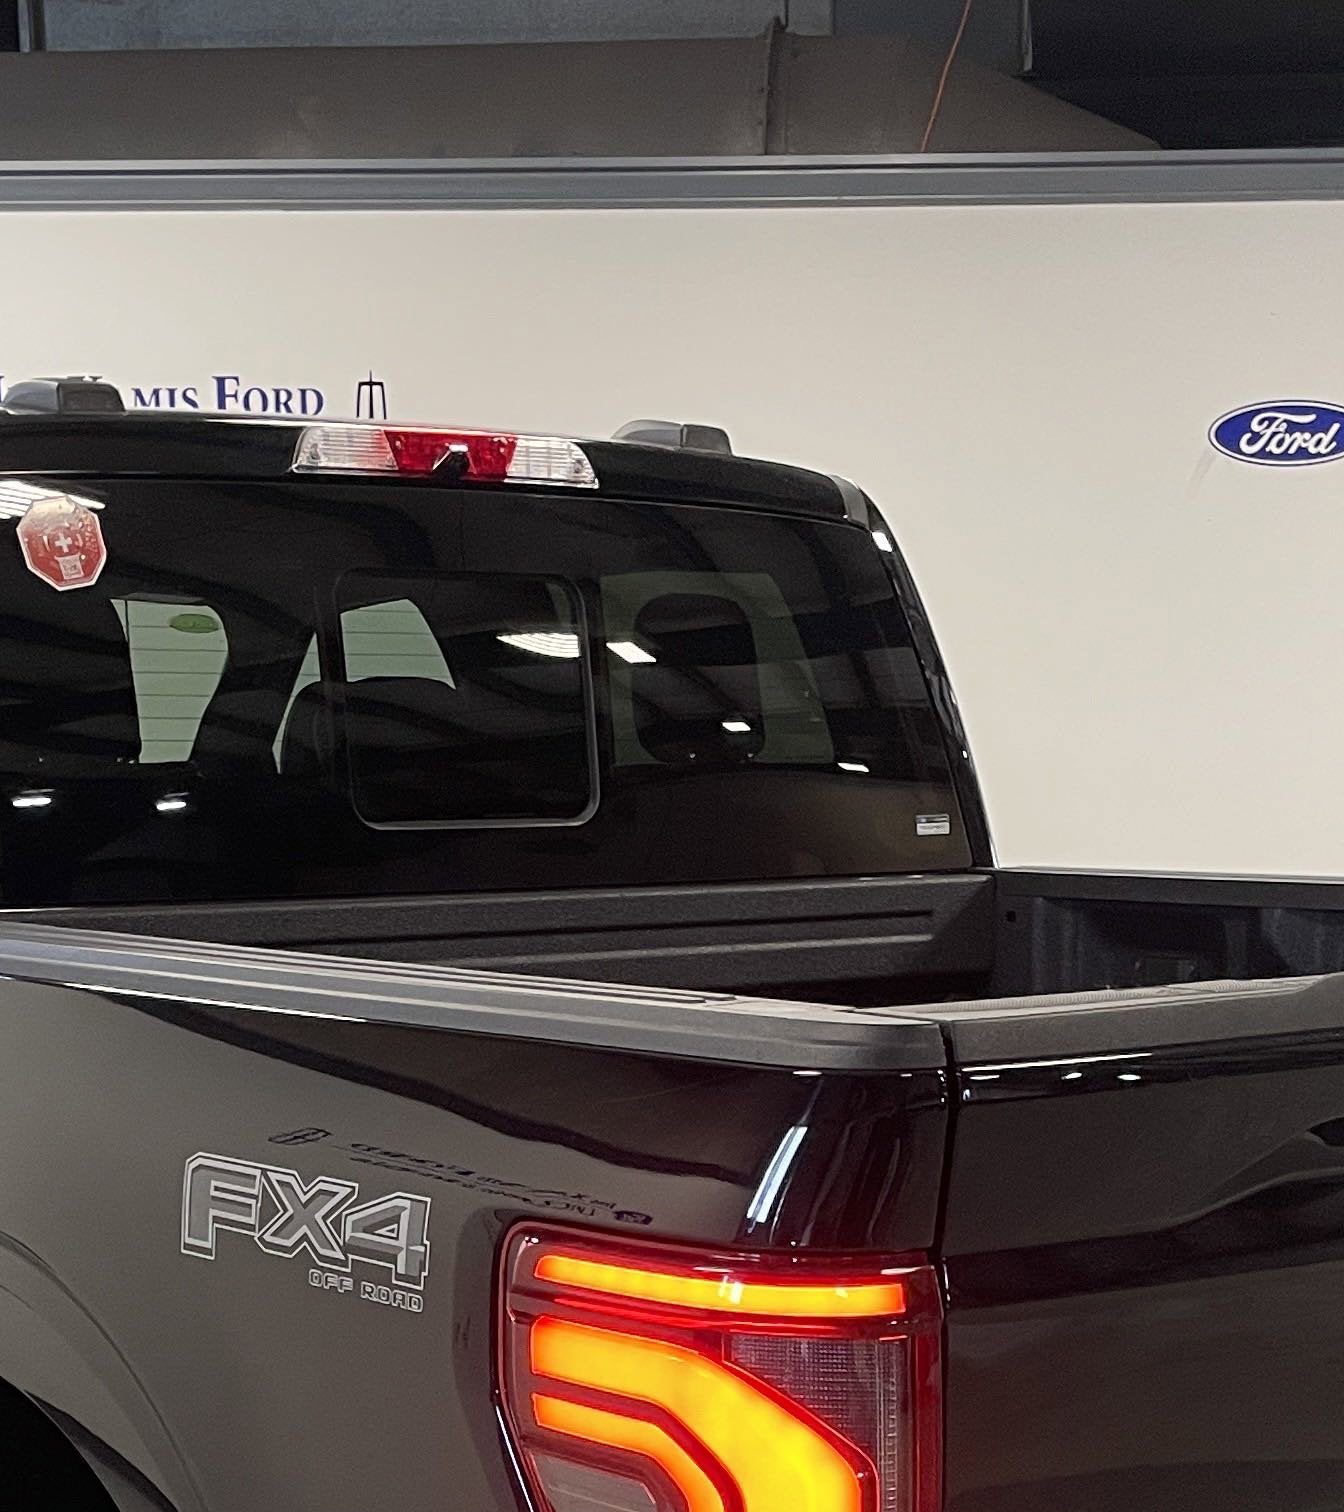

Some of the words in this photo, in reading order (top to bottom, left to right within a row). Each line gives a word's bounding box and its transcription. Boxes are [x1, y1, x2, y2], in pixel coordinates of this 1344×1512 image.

[1239, 412, 1341, 456] Ford
[181, 1151, 431, 1290] FX4
[309, 1268, 354, 1293] OFF
[360, 1281, 424, 1313] ROAD
